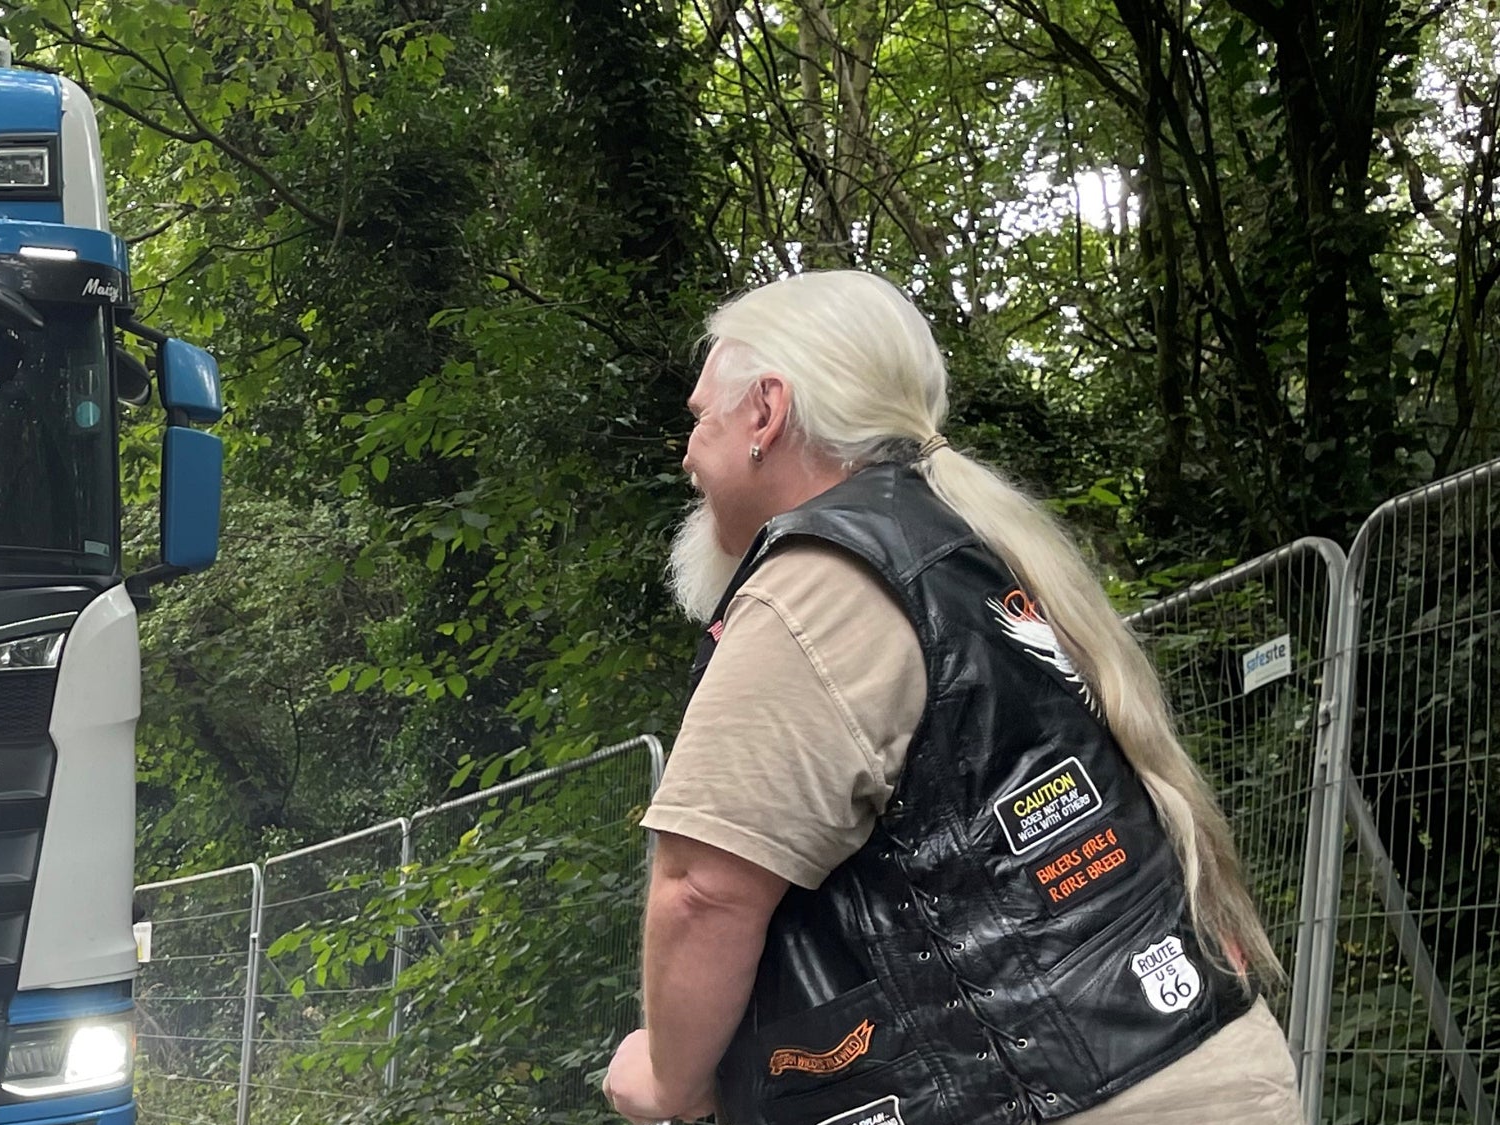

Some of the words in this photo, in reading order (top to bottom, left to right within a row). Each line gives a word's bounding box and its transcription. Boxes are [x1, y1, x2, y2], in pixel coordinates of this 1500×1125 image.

[1013, 772, 1076, 817] CAUTION
[1020, 810, 1043, 829] DOES
[1043, 799, 1060, 816] NOT
[1060, 788, 1080, 807] PLAY
[1017, 825, 1042, 842] WELL
[1040, 813, 1062, 830] WITH
[1062, 793, 1091, 817] OTHERS
[1036, 848, 1082, 885] BIKERS
[1082, 833, 1108, 860] ARE
[1105, 828, 1117, 846] A
[1048, 871, 1088, 903] RARE
[1086, 848, 1127, 880] BREED
[1137, 941, 1177, 973] ROUTE
[1160, 973, 1192, 1007] 66
